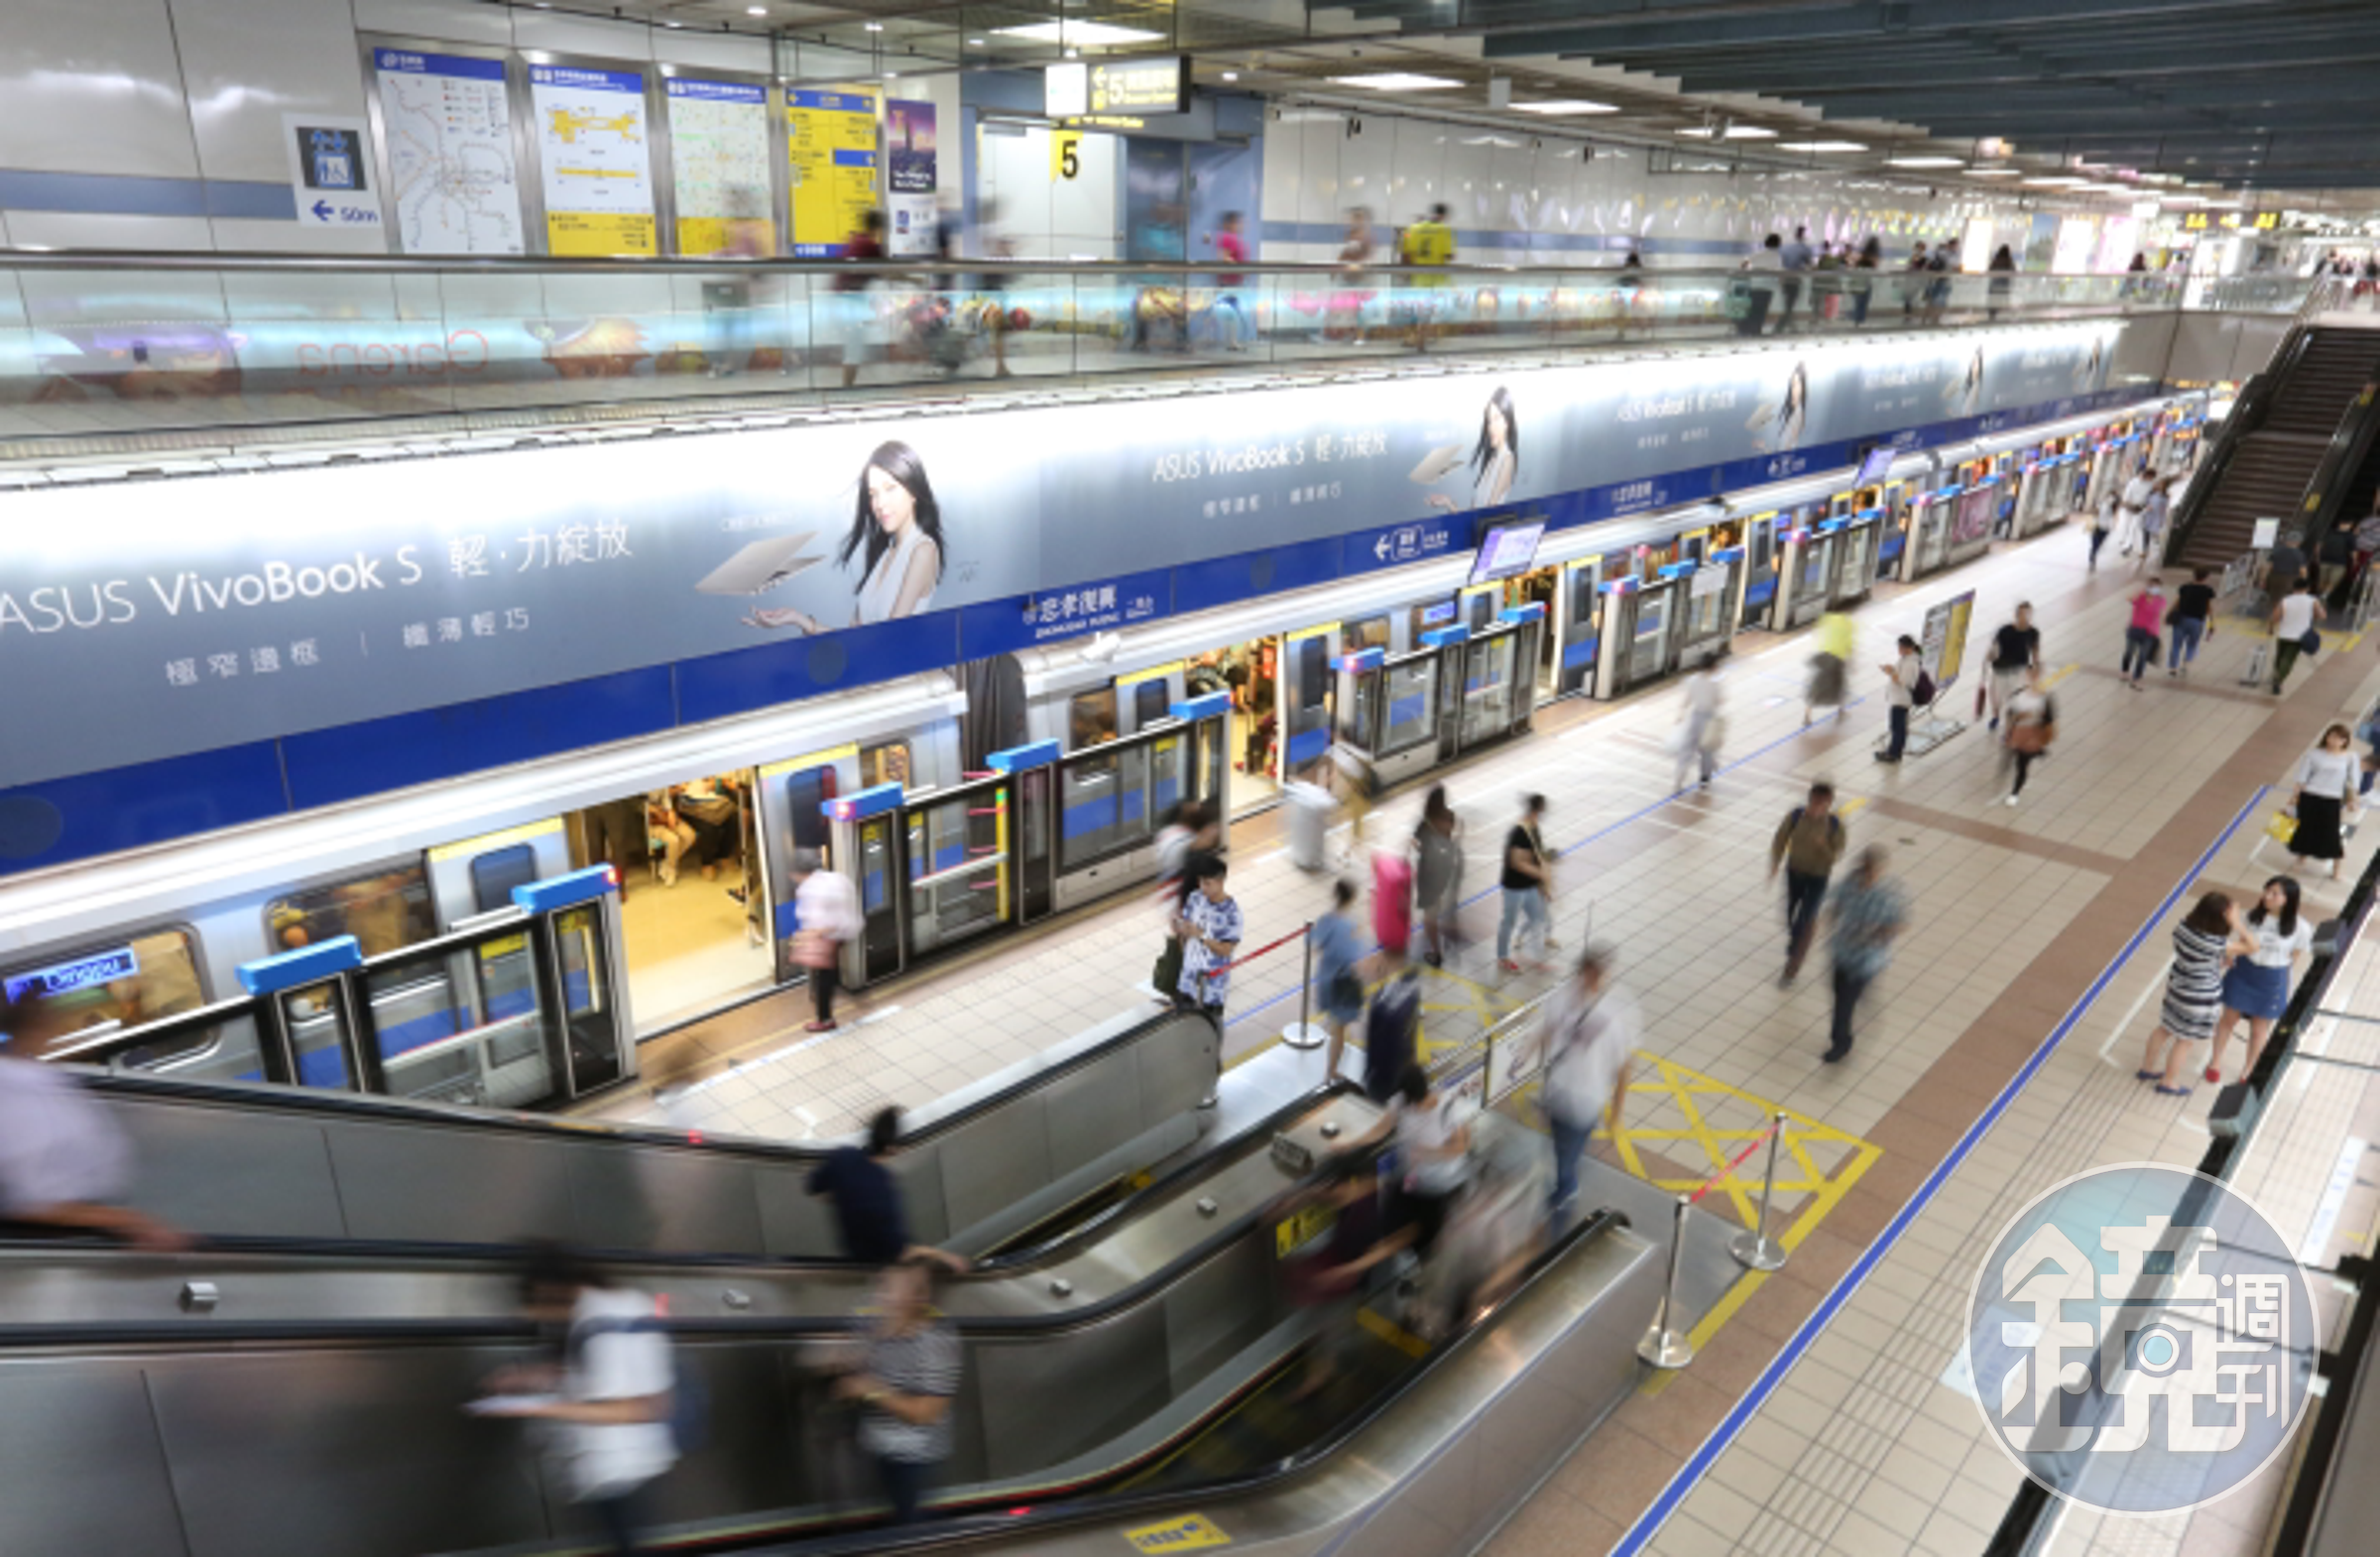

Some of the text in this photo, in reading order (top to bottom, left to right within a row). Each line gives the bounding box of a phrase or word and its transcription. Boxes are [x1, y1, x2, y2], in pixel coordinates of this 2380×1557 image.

[1062, 140, 1078, 179] 5
[1152, 449, 1201, 482] ASUS
[1206, 442, 1291, 476] VivoBook
[0, 579, 137, 634] ASUS
[148, 550, 385, 616] VivoBook
[396, 544, 422, 585] S
